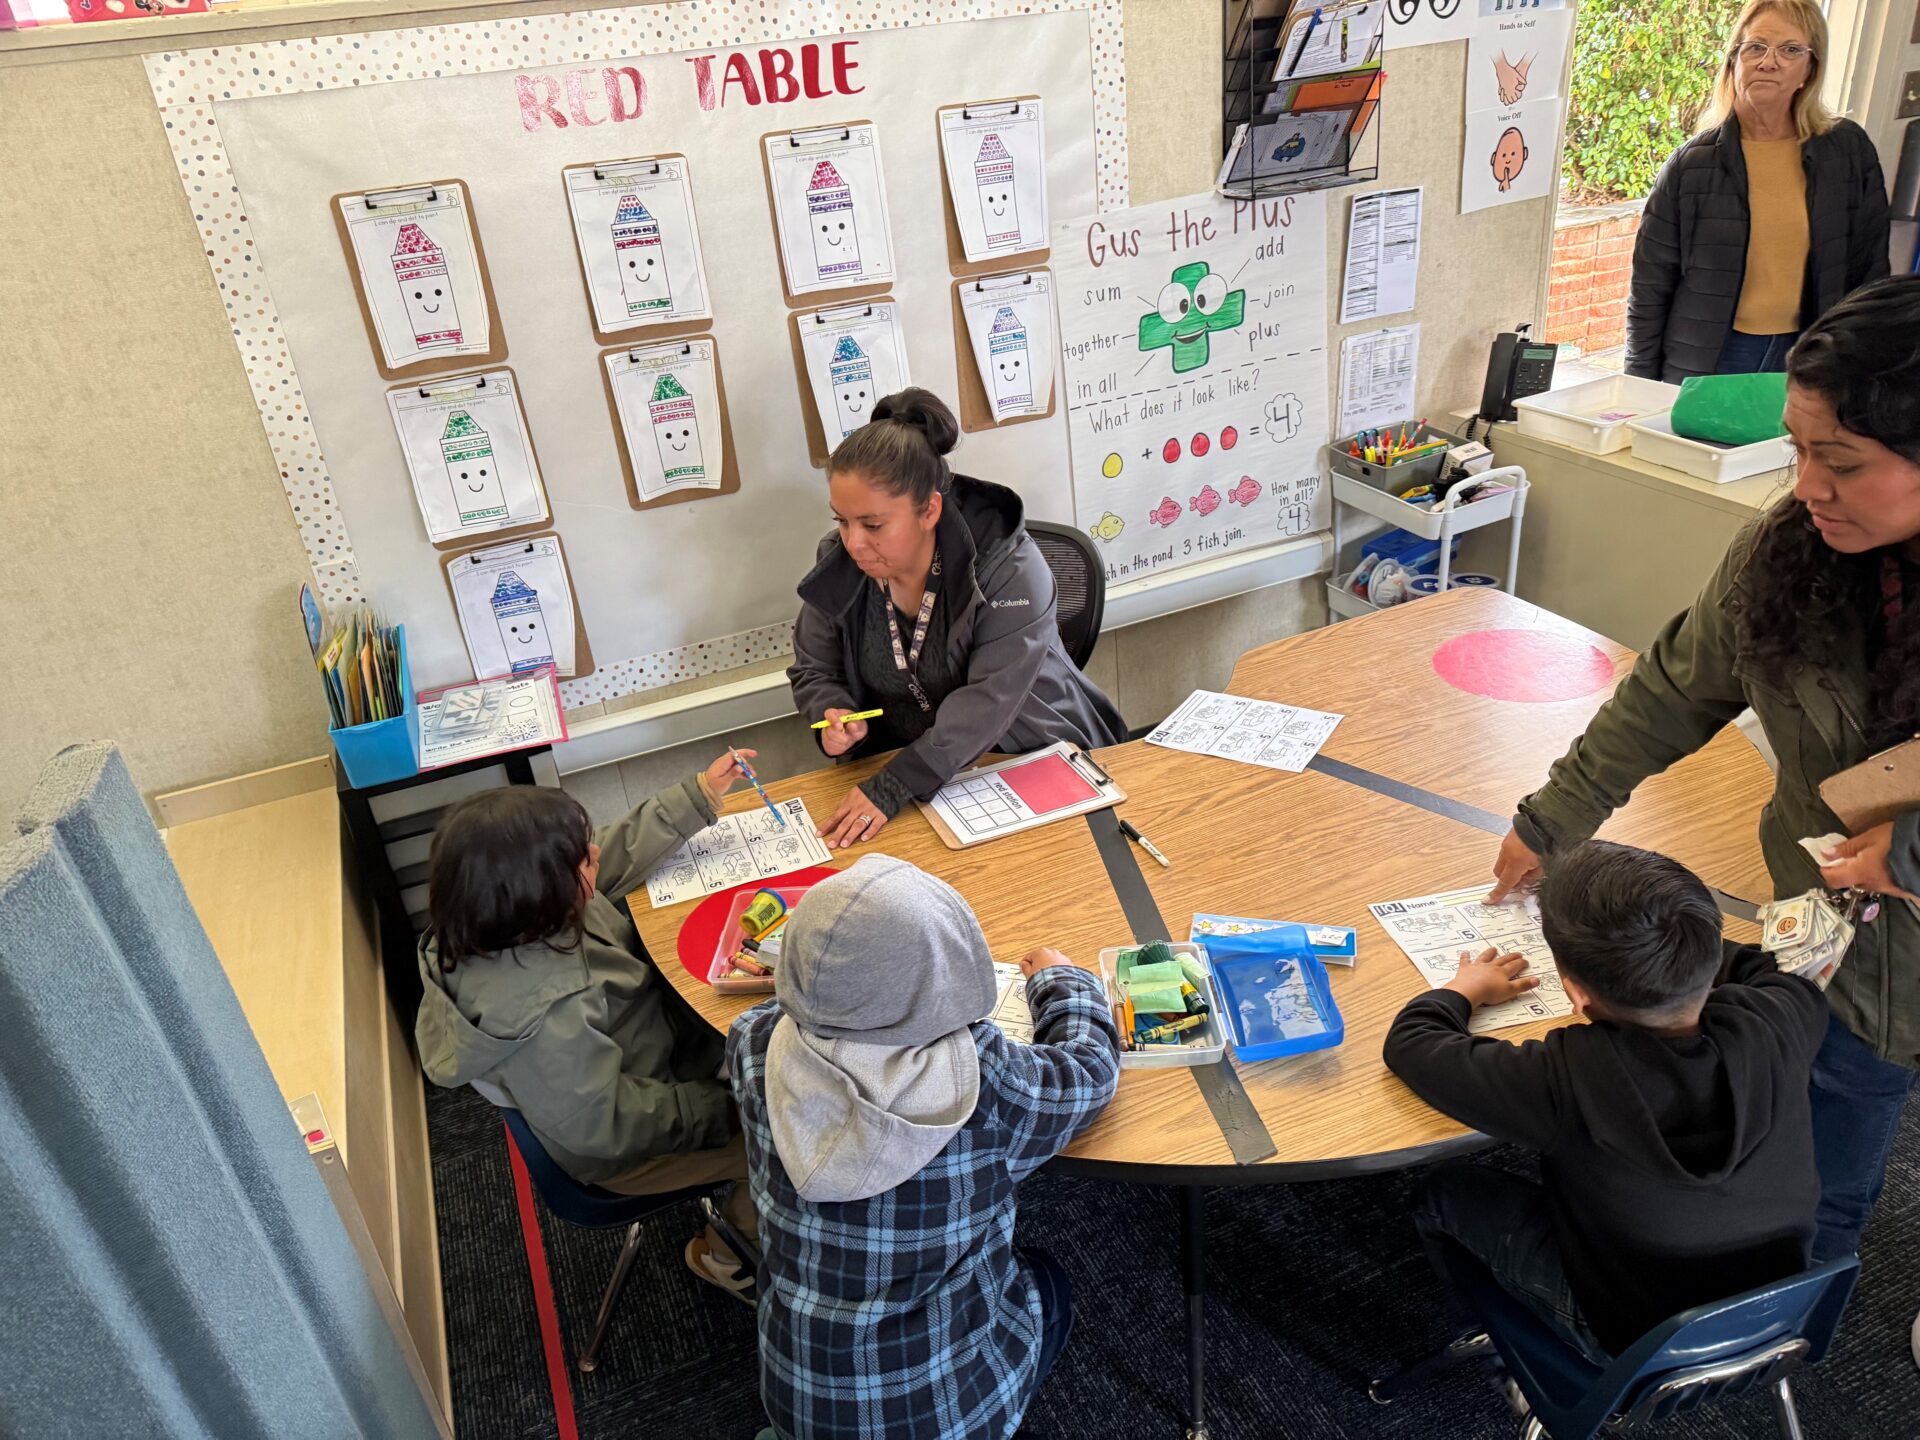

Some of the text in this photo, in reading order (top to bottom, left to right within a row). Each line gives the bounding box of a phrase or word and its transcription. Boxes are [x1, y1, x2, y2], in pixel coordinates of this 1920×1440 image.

[1499, 19, 1536, 31] Hands to Self
[514, 41, 866, 133] RED TABLE
[1512, 111, 1522, 120] Off
[1087, 196, 1296, 268] Gus the Plus
[1255, 235, 1285, 261] add
[1084, 285, 1121, 306] sum
[1263, 284, 1295, 309] join
[1064, 332, 1118, 361] together
[1248, 321, 1281, 351] plus
[1078, 373, 1117, 400] in all
[1089, 368, 1260, 434] What does it look like?
[1273, 403, 1291, 434] 4
[1271, 474, 1321, 496] How many
[1279, 487, 1314, 506] in all?
[1288, 507, 1301, 532] 4
[1105, 528, 1246, 582] sh in the pond. 3 fish join.
[998, 598, 1030, 607] Columbia
[993, 782, 1022, 809] red station
[749, 835, 762, 843] 5
[696, 848, 710, 857] 5
[764, 865, 778, 874] 5
[709, 880, 723, 889] 5
[658, 894, 672, 902] 5
[1461, 930, 1476, 940] 5
[1529, 1004, 1544, 1015] 5
